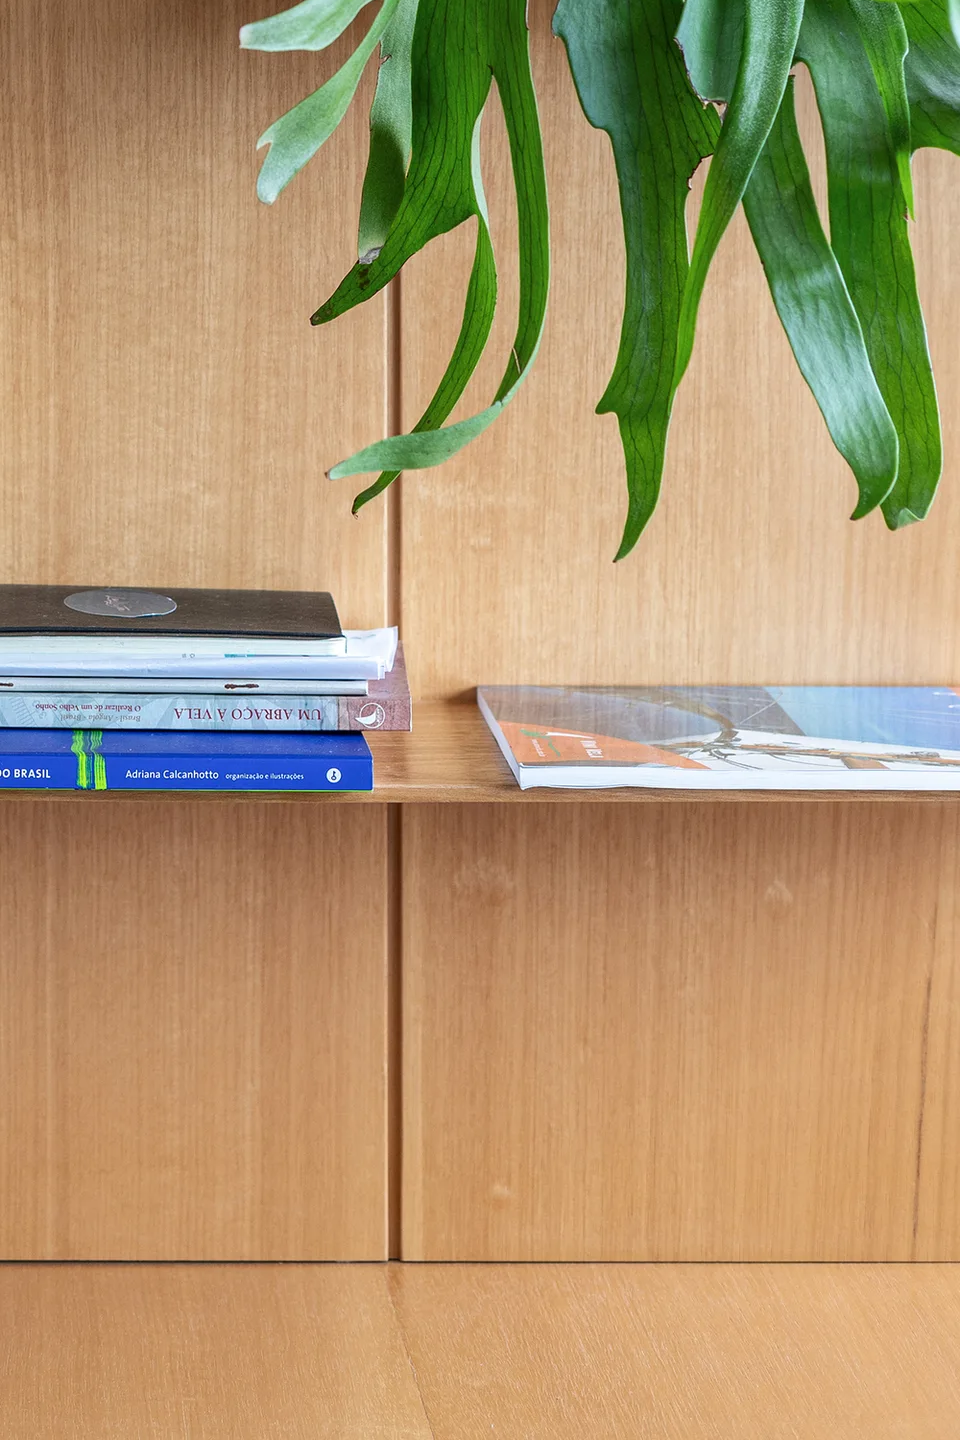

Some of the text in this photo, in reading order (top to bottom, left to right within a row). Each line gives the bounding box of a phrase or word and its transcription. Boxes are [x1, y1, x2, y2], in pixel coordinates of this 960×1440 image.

[35, 703, 58, 712] Sonho
[59, 704, 80, 712] Velho
[94, 704, 104, 712] de
[104, 704, 133, 712] Realizar
[134, 704, 142, 712] O
[173, 707, 322, 721] UM ABRAÇO À VELA
[14, 768, 51, 779] BRASIL
[125, 769, 161, 779] Adriana
[163, 769, 219, 780] Calcanhotto
[225, 772, 264, 781] organização
[270, 772, 305, 781] ilustrações
